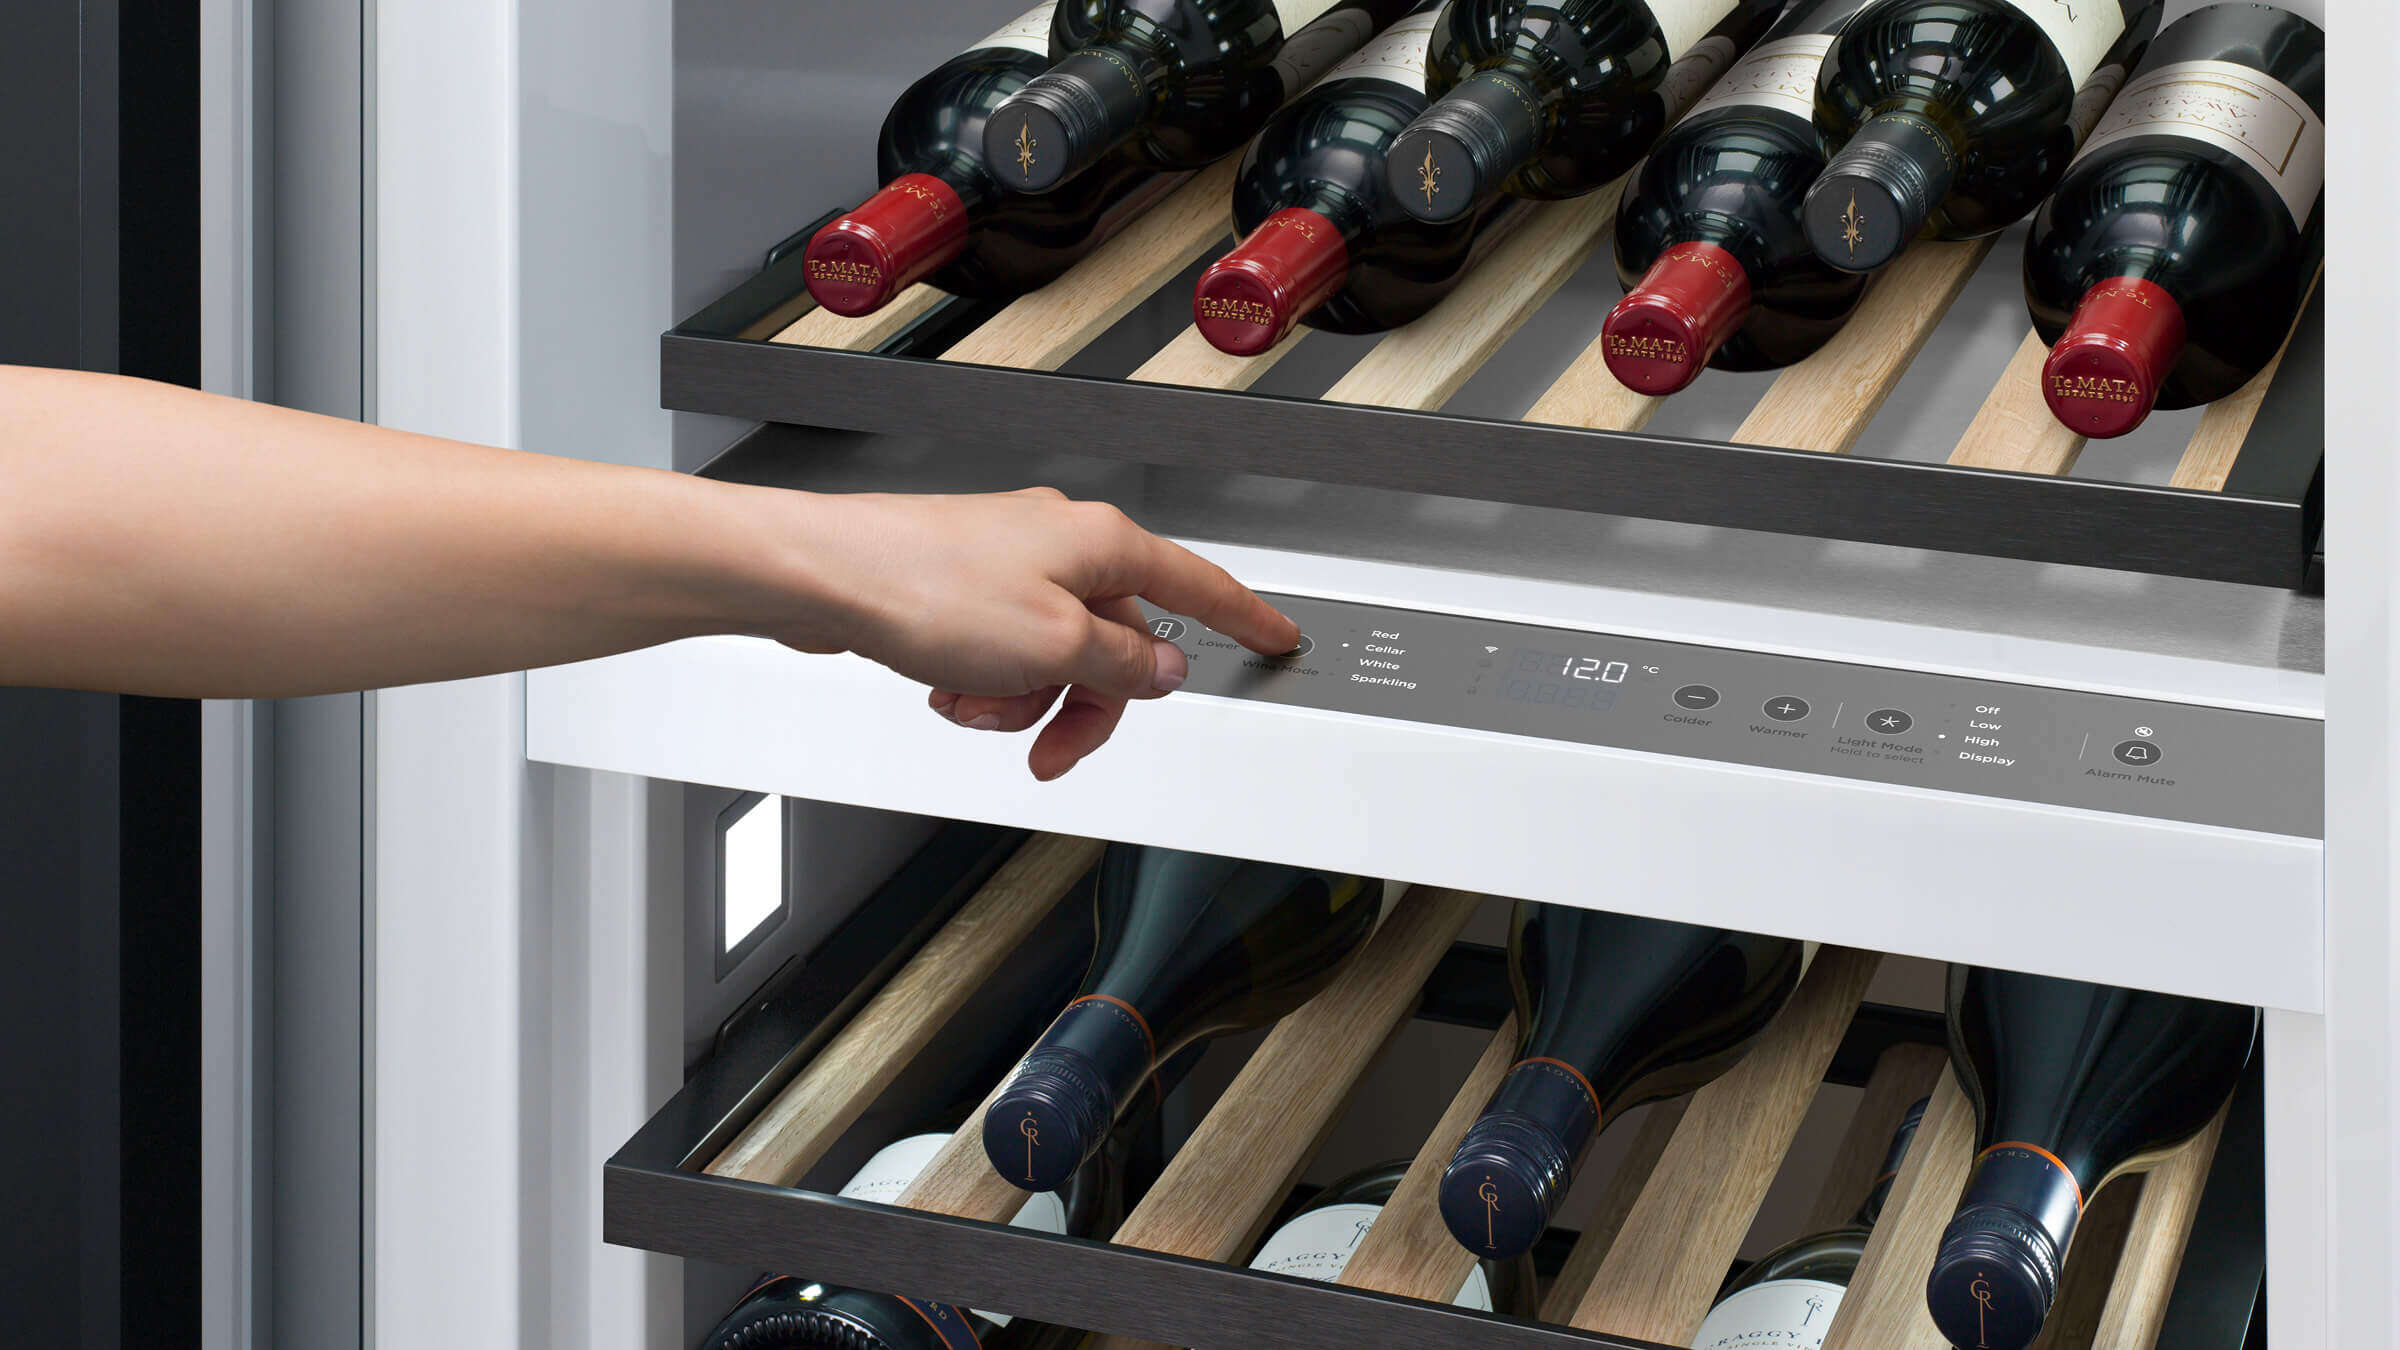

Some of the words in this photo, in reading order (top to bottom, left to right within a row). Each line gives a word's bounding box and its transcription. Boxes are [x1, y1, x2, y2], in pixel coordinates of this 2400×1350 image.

[831, 261, 881, 278] MATA
[813, 273, 853, 283] ESTATE
[1222, 298, 1275, 317] MATA
[1204, 310, 1246, 321] ESTATE
[1631, 336, 1687, 355] MATA
[1612, 348, 1656, 359] ESTATE
[2051, 375, 2073, 389] Te
[2077, 376, 2140, 396] MATA
[2057, 389, 2105, 400] ESTATE
[1371, 630, 1400, 640] Red
[1198, 638, 1241, 651] Lower
[1365, 644, 1406, 656] Cellar
[1280, 664, 1319, 677] Mode
[1359, 658, 1400, 671] White
[1562, 656, 1629, 684] 12.0
[1350, 673, 1417, 690] Sparkling
[1975, 705, 2001, 716] Off
[1663, 713, 1713, 728] Colder
[1969, 719, 2003, 731] Low
[1749, 724, 1808, 741] Warmer
[1837, 736, 1877, 749] Light
[1881, 742, 1923, 754] Mode
[1964, 735, 2000, 747] High
[1830, 746, 1862, 757] Hold
[1866, 751, 1880, 759] to
[1884, 753, 1924, 765] select
[1959, 751, 2017, 767] Display
[2085, 767, 2132, 783] Alarm
[2136, 774, 2176, 788] Mute
